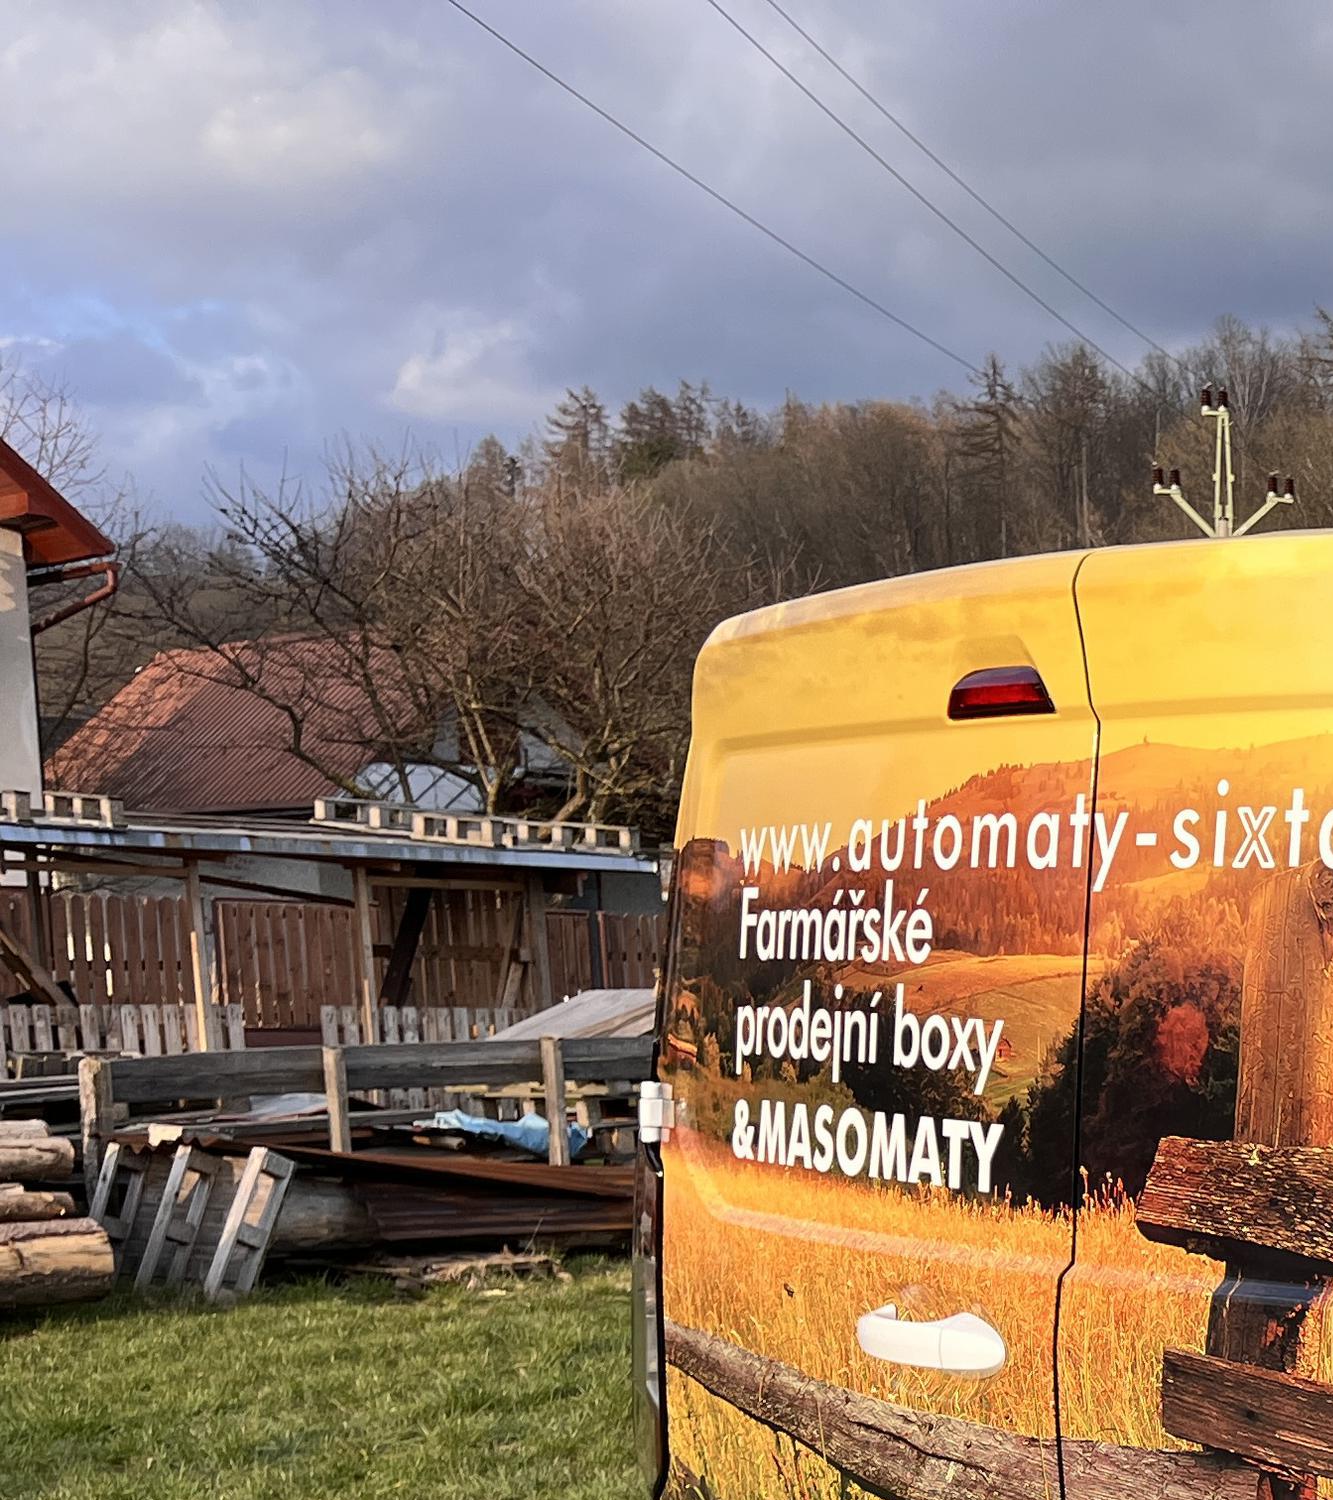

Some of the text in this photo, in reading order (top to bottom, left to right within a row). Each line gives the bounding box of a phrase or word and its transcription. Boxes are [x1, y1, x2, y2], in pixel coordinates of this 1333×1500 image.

[738, 880, 934, 965] Farmářské
[734, 979, 1005, 1094] prodejní boxy
